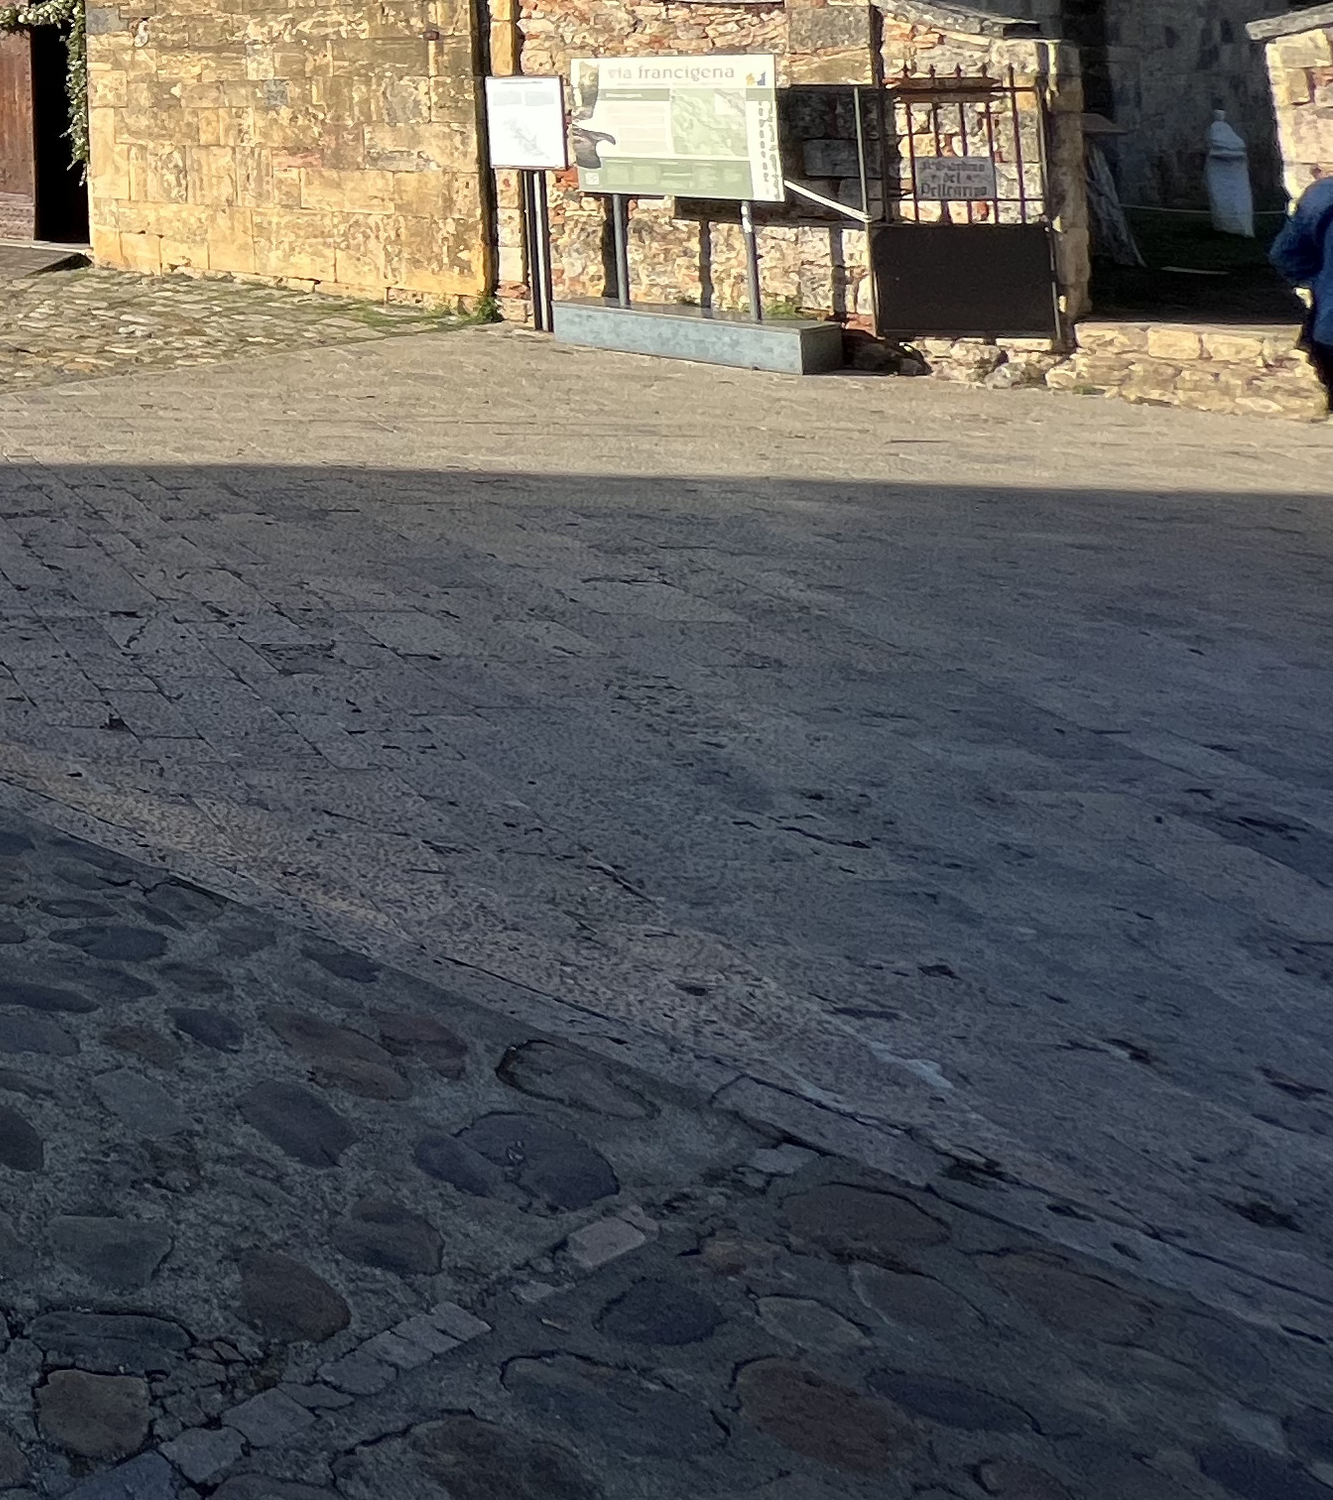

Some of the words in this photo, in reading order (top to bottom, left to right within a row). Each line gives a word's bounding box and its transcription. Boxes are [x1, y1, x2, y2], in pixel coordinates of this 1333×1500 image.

[638, 65, 735, 82] francigena
[943, 172, 961, 184] del
[921, 182, 988, 198] Pellegrino
